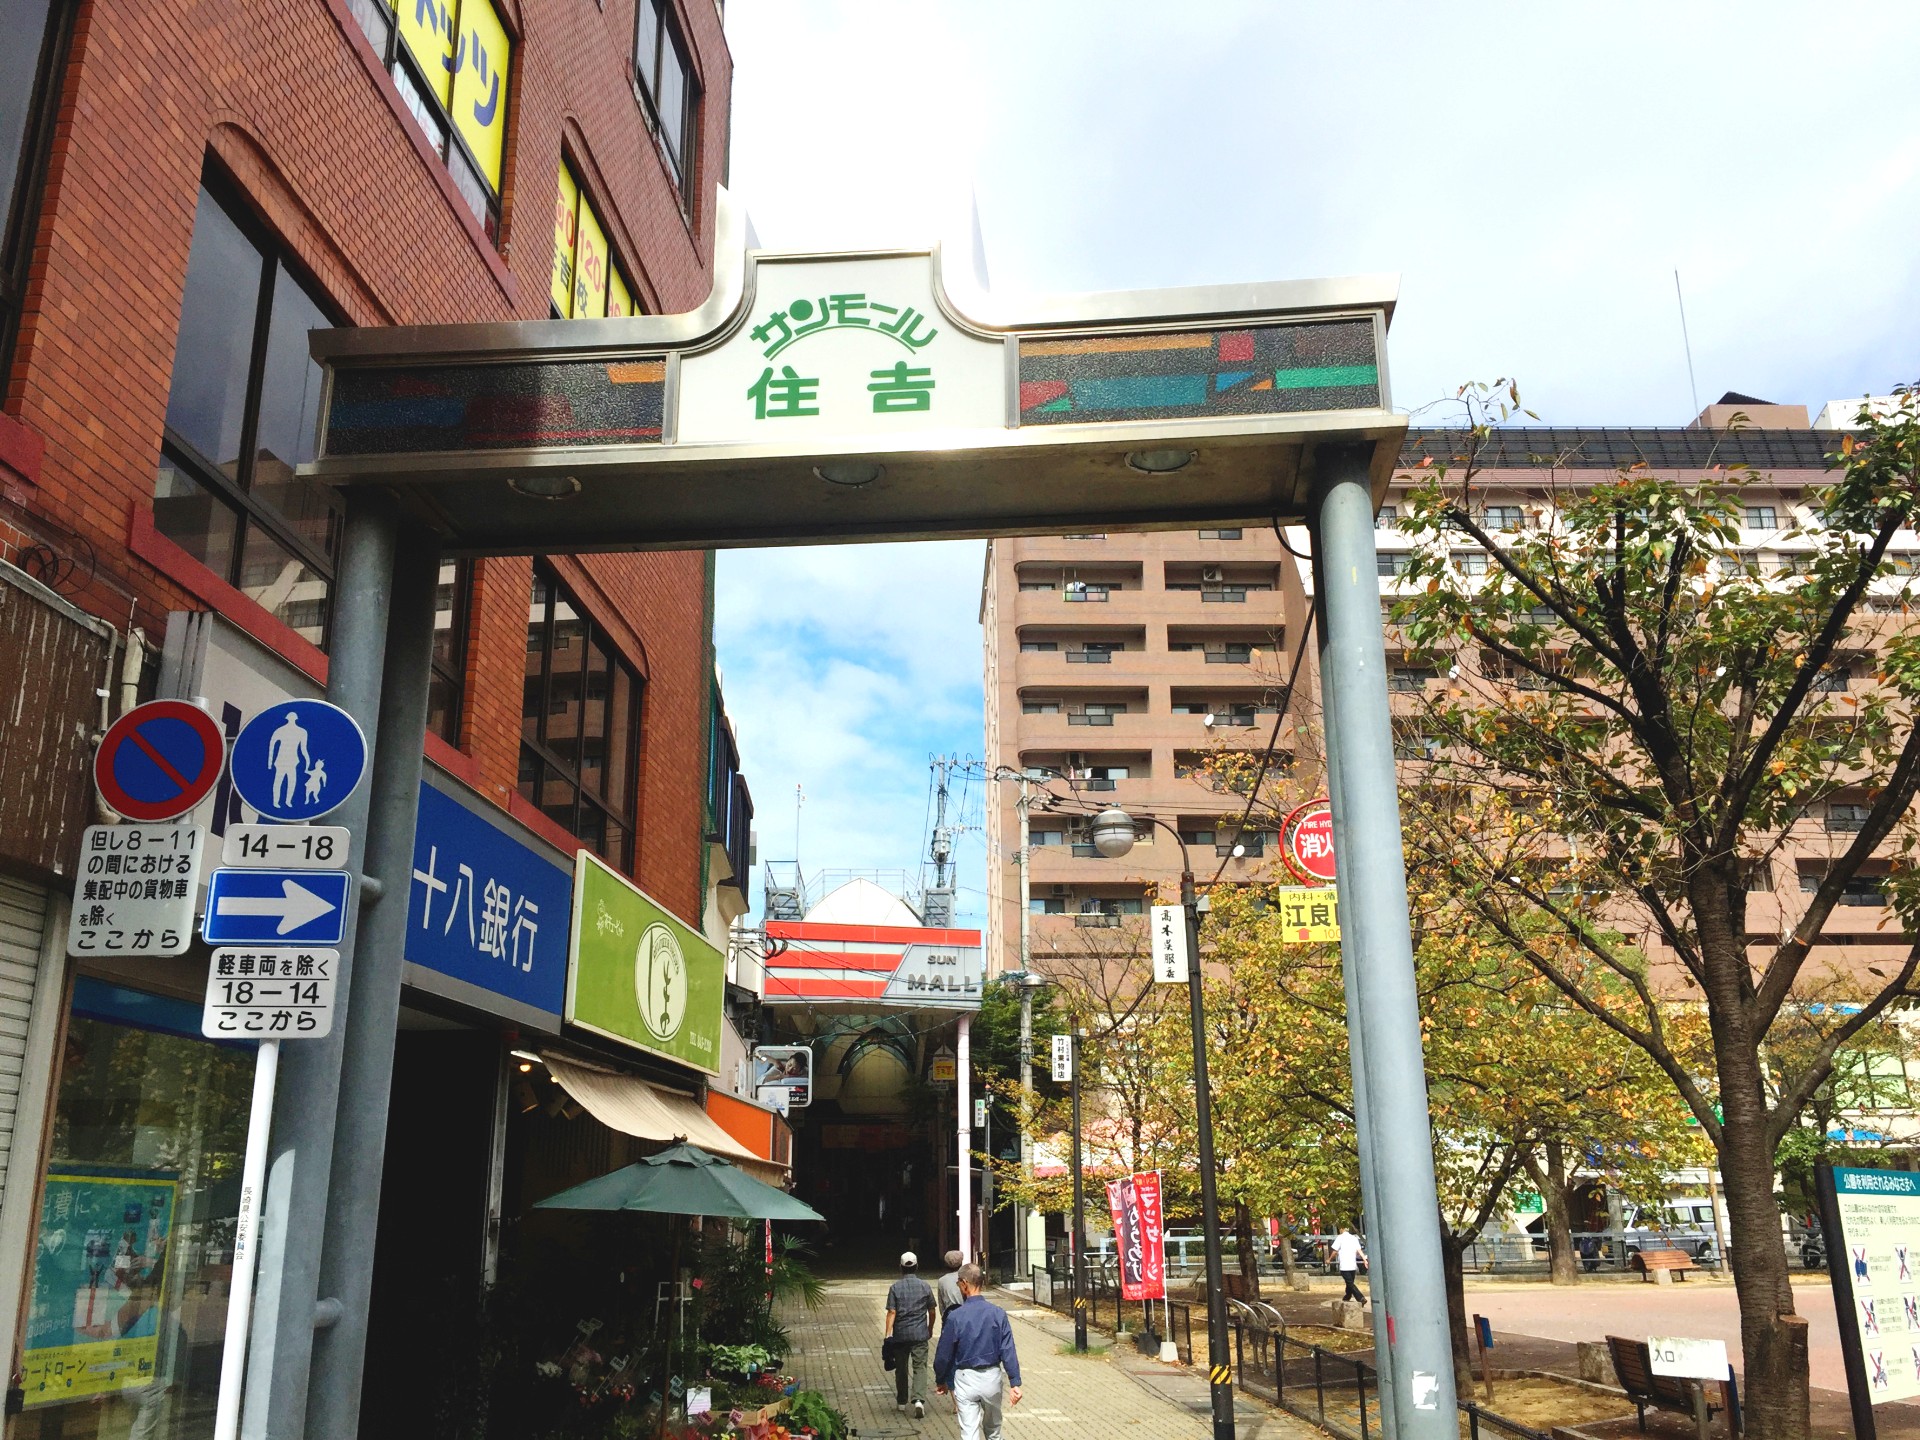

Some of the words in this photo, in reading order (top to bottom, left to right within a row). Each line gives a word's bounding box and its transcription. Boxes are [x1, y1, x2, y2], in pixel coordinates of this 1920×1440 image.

[750, 294, 938, 358] サンモール
[747, 361, 936, 420] 住吉
[1303, 821, 1318, 829] FIRE
[87, 854, 192, 875] の間における
[83, 879, 188, 900] 集配中の貨物車
[79, 905, 115, 926] を除く
[413, 845, 540, 973] 十八銀行
[77, 929, 180, 949] ここから
[217, 954, 329, 976] 軽車両を除く
[927, 955, 957, 966] SUN
[907, 974, 977, 993] MALL
[218, 1010, 317, 1031] ここから
[1654, 1348, 1675, 1363] 入口
